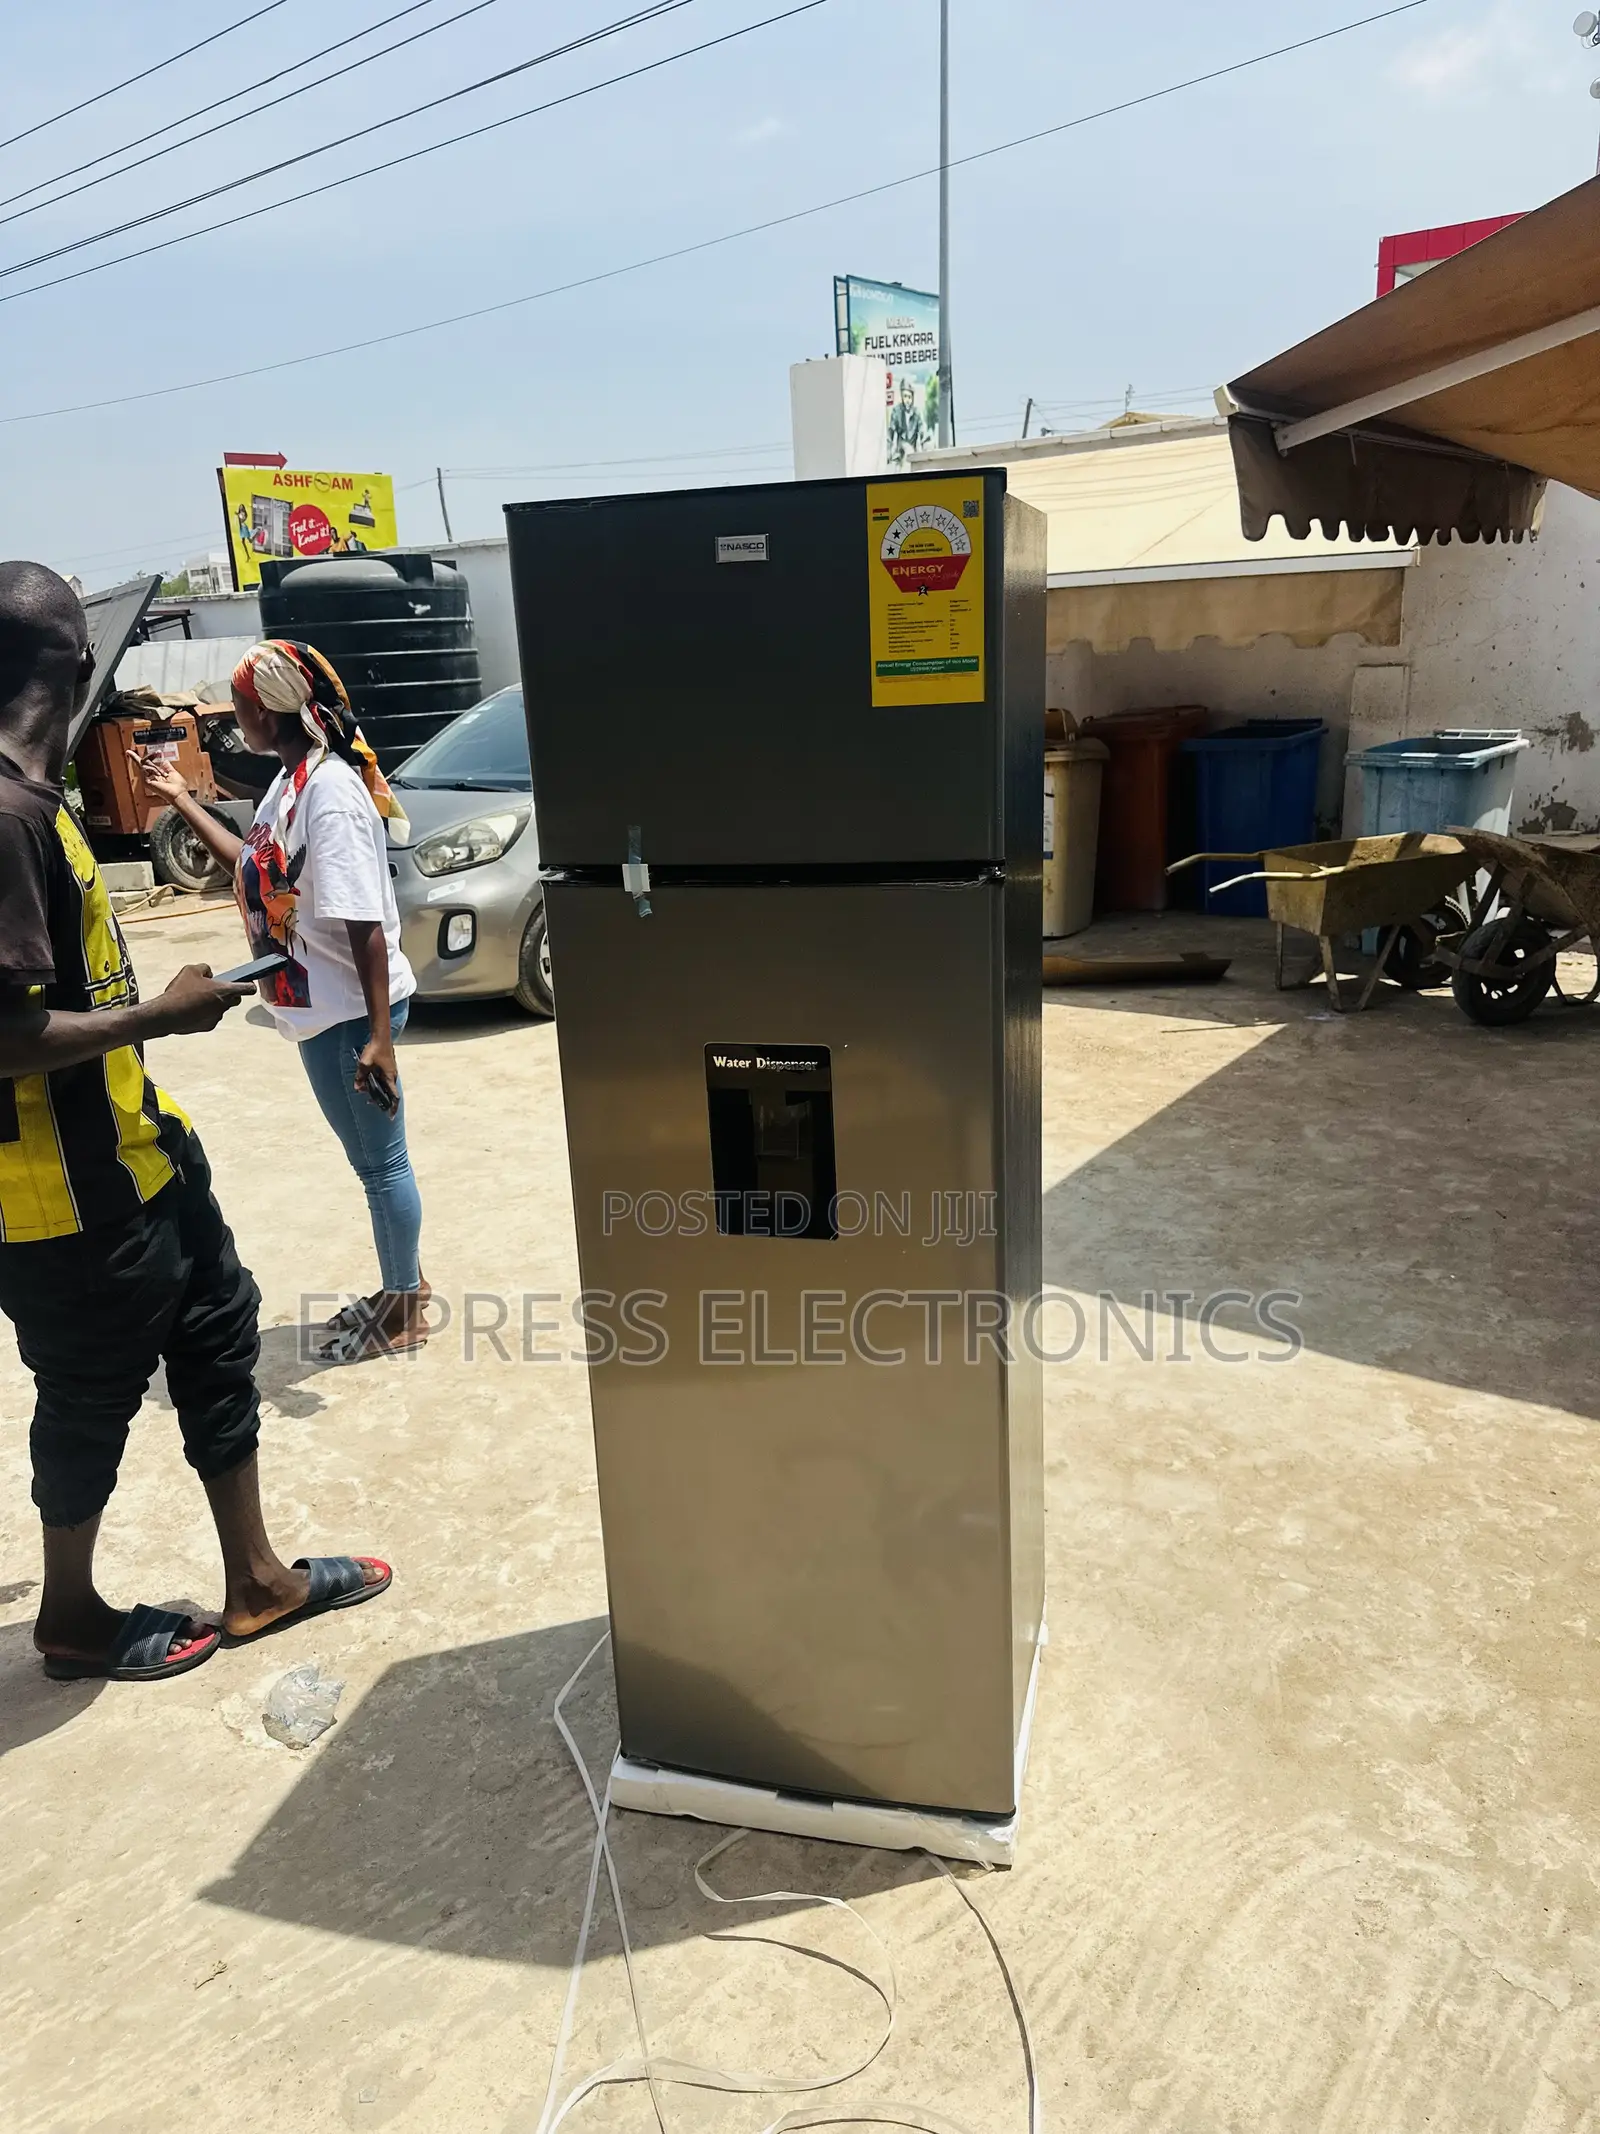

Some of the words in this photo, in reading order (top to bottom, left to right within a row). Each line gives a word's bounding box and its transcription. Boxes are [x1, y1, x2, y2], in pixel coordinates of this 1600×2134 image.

[865, 335, 891, 350] FUEL
[905, 349, 937, 364] BEBRE
[290, 519, 307, 536] Feel
[297, 531, 319, 547] Know
[892, 564, 944, 576] ENERGY
[713, 1056, 752, 1068] Water
[756, 1057, 818, 1072] Dispenser
